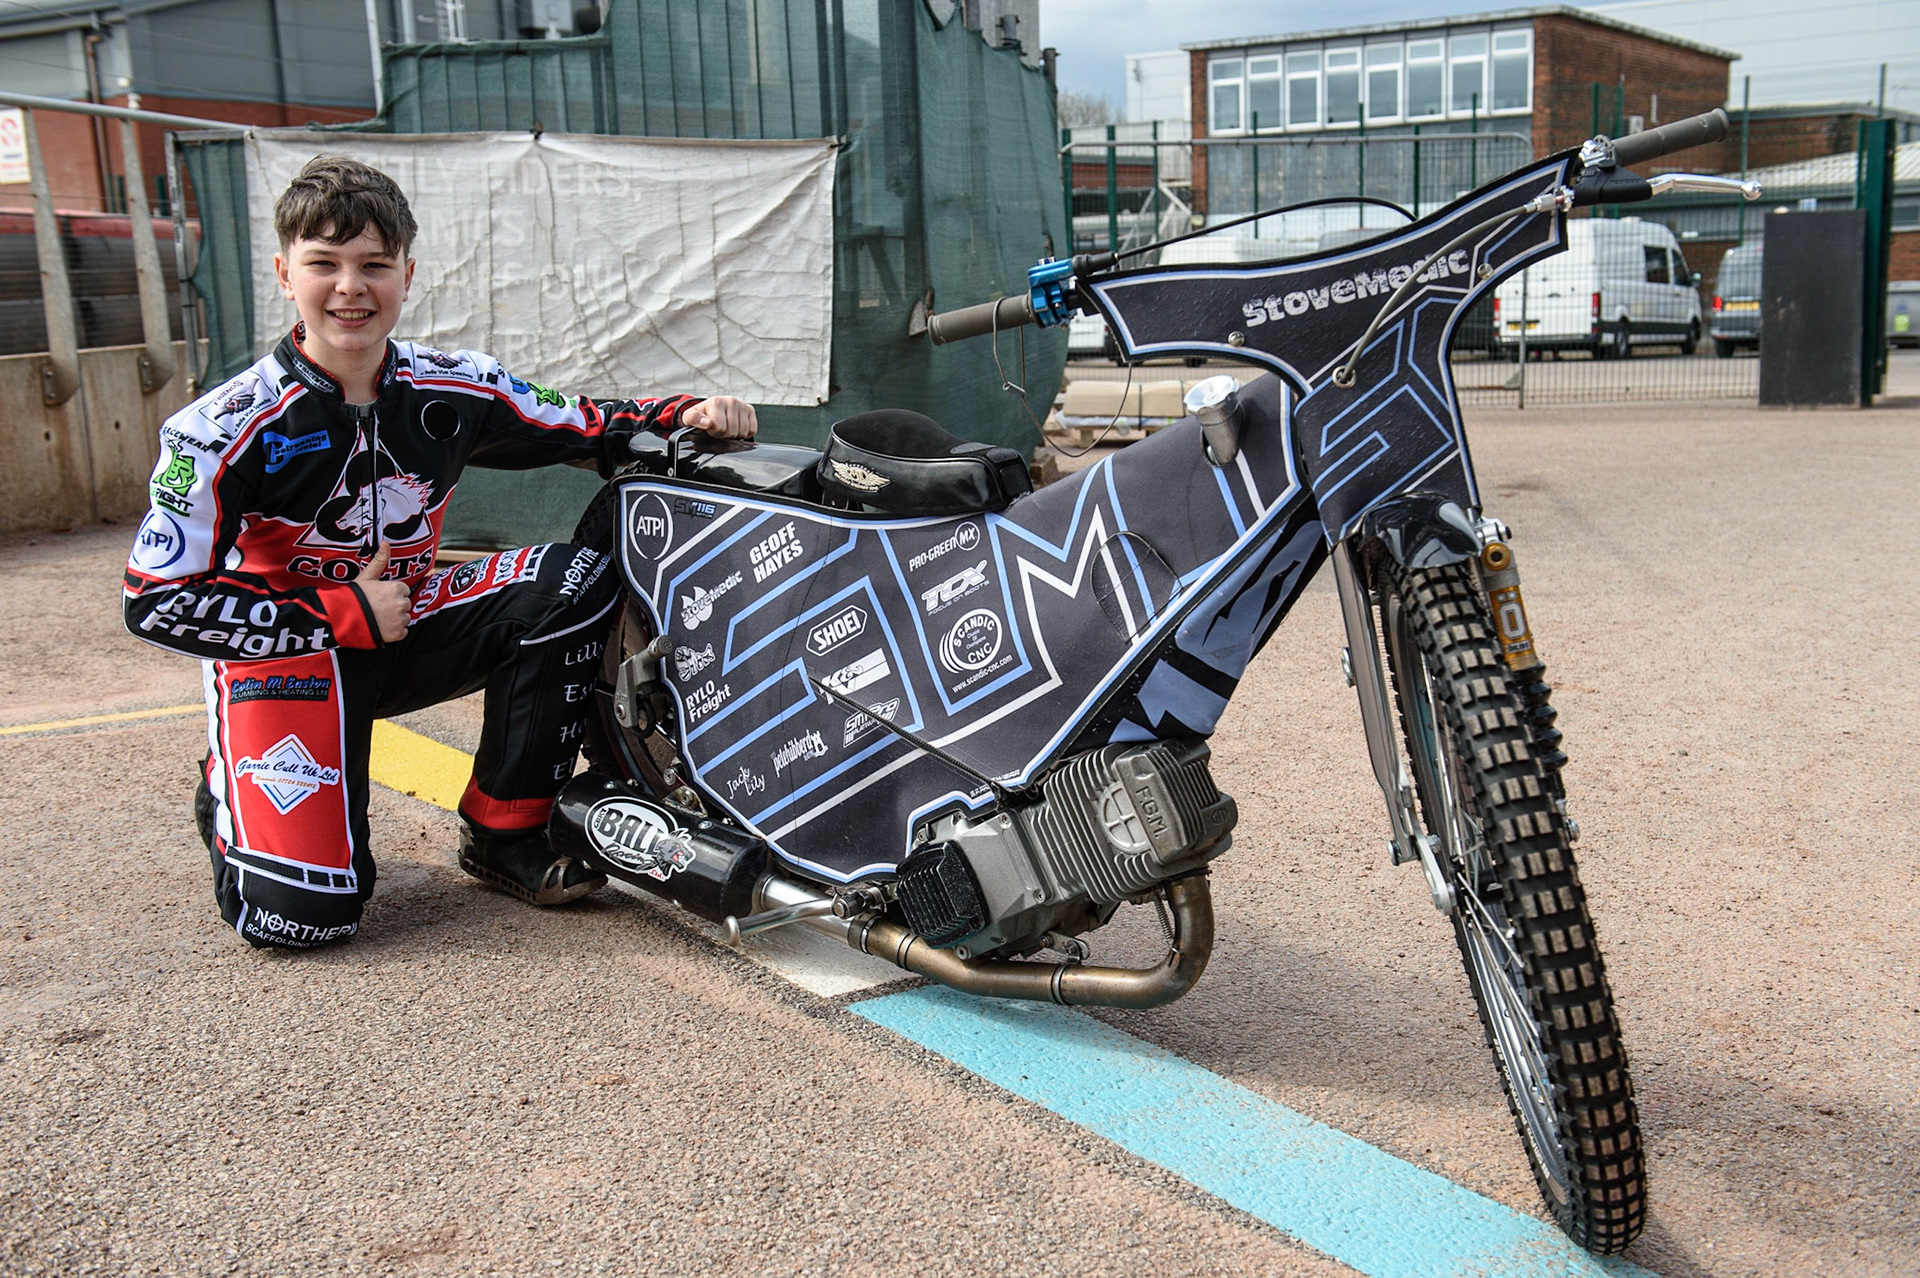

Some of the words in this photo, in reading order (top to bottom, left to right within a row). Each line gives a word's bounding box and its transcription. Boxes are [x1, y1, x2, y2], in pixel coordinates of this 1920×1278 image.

[635, 515, 665, 538] ATPI
[749, 520, 796, 565] GEOFF
[752, 539, 804, 584] HAYES
[909, 535, 958, 572] PRO-GREEN
[959, 526, 976, 546] MX
[921, 559, 988, 612] TCX
[155, 590, 279, 628] RYLO
[138, 609, 330, 659] Freight
[813, 610, 862, 651] SHOEI
[953, 615, 996, 649] SCANDIC
[967, 642, 994, 664] CNC
[232, 677, 262, 695] Colin
[265, 676, 284, 689] M
[285, 675, 330, 690] Easton
[951, 654, 1014, 693] www.scandic-cnc.com
[230, 688, 269, 700] PLUMBING
[279, 688, 315, 697] HEATING
[685, 680, 715, 711] RYLO
[688, 683, 732, 723] Freight
[238, 760, 270, 775] Garrie
[273, 761, 299, 774] Cull
[318, 768, 338, 782] Ltd
[597, 808, 664, 856] BALL
[246, 923, 311, 948] SCAFFOLDING
